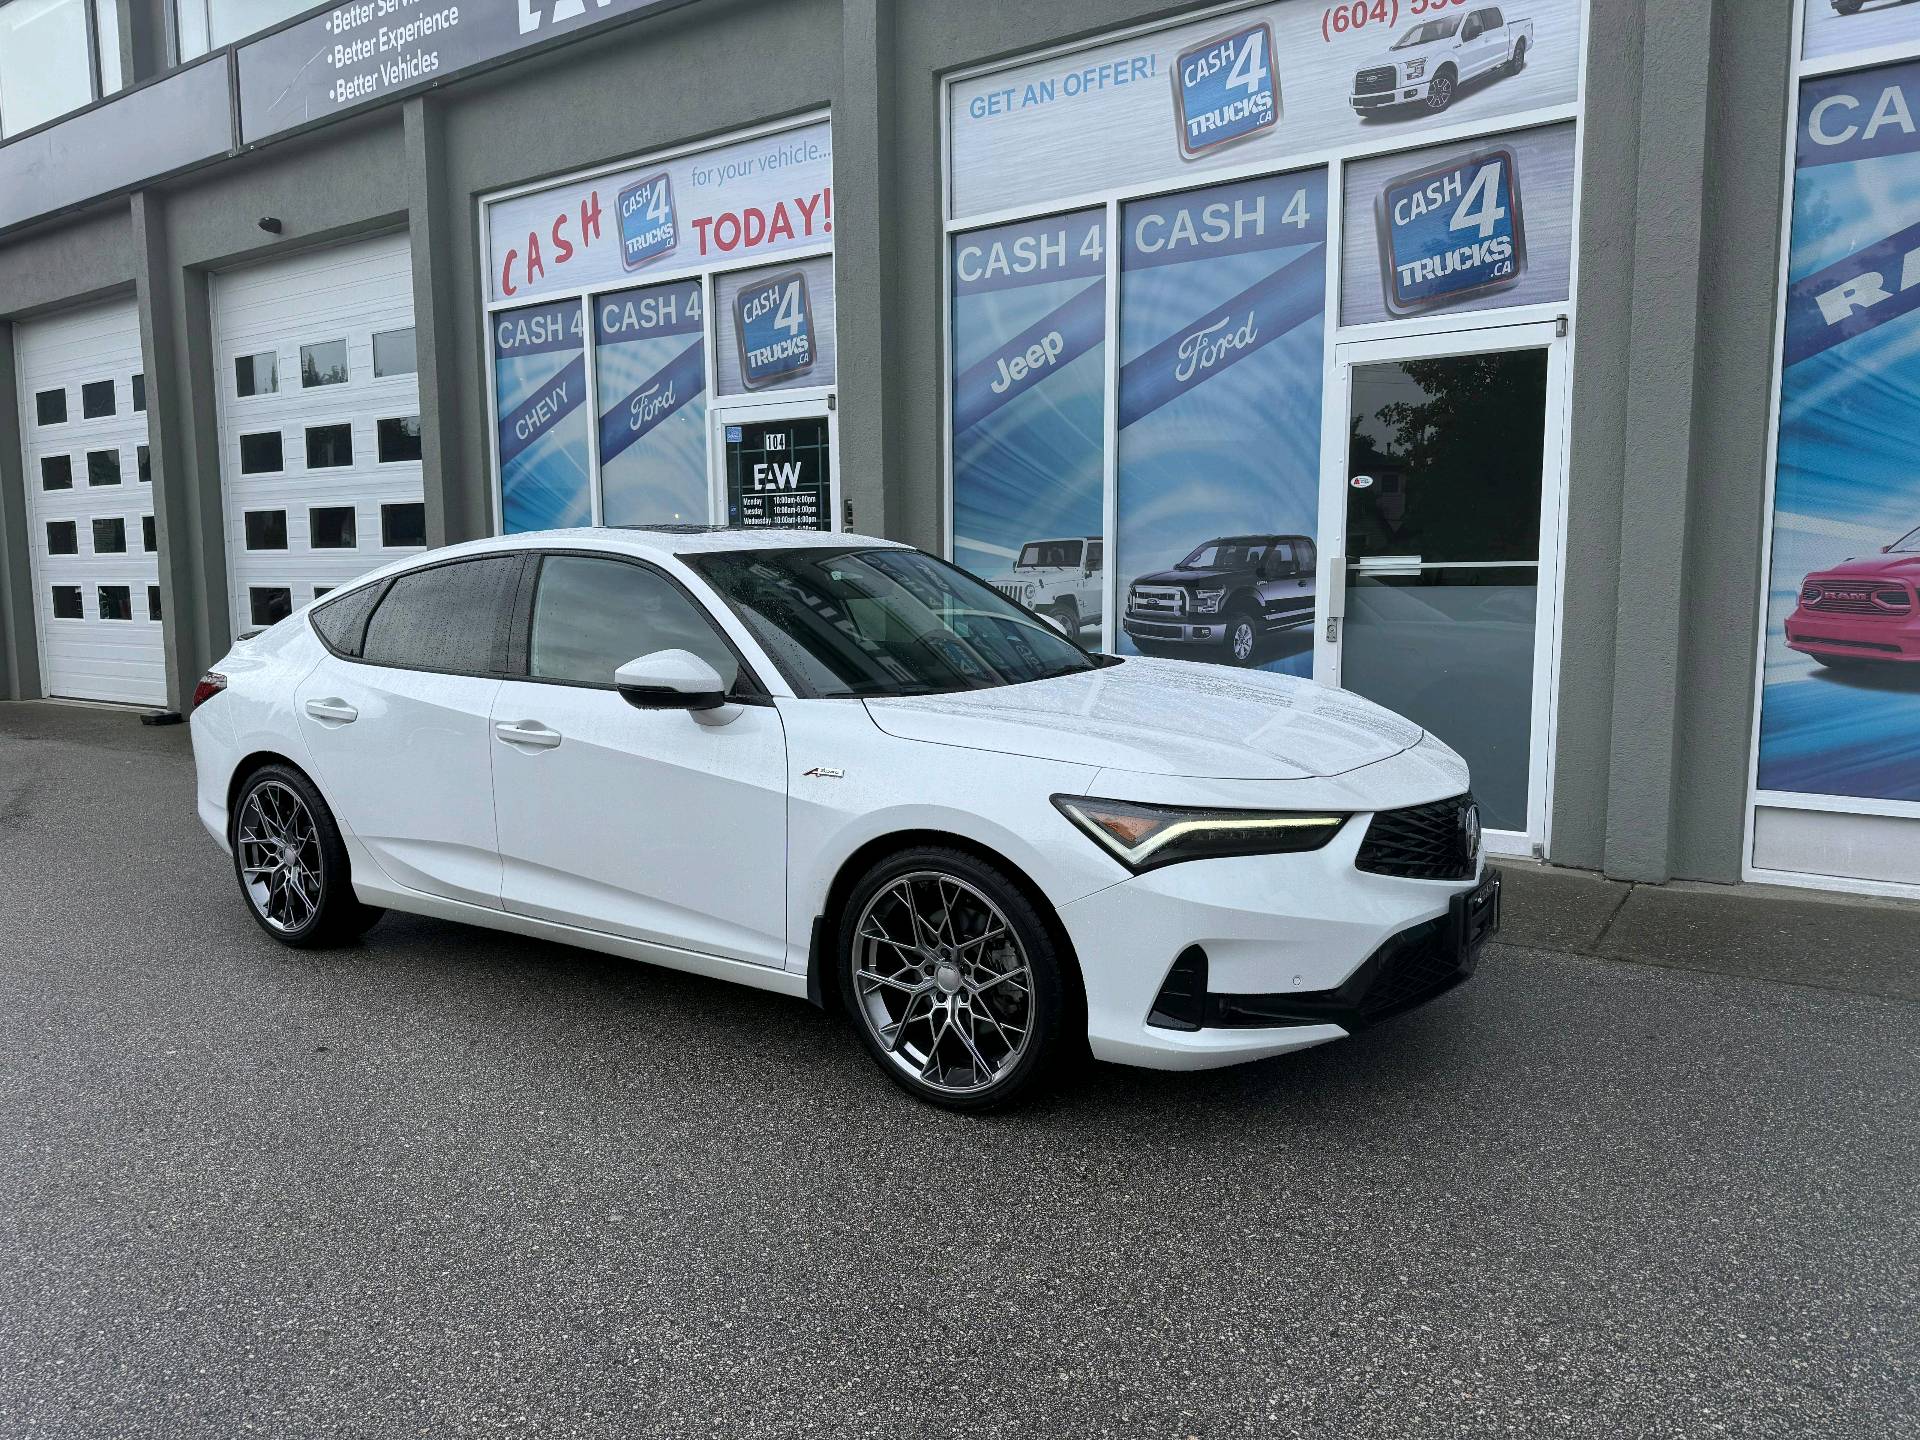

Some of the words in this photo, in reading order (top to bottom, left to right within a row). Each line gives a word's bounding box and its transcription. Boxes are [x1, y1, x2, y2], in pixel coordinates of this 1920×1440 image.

[333, 2, 375, 35] Better
[335, 37, 376, 68] Better
[379, 6, 459, 52] Experience
[1322, 0, 1399, 42] (604)
[337, 71, 378, 103] Better
[380, 49, 439, 86] Vehicles
[969, 88, 1016, 119] GET
[1021, 79, 1055, 108] AN
[1063, 54, 1156, 96] OFFER!
[1184, 41, 1236, 88] CASH
[1225, 30, 1268, 94] 4
[1187, 90, 1273, 137] TRUCKS
[692, 166, 714, 187] for
[717, 159, 753, 187] your
[622, 183, 651, 218] CASH
[646, 178, 670, 224] 4
[691, 187, 833, 256] TODAY!
[1135, 195, 1265, 253] CASH
[1281, 189, 1311, 229] 4
[1394, 170, 1463, 227] CASH
[1449, 161, 1505, 238] 4
[502, 190, 602, 296] CASH
[625, 222, 674, 254] TRUCKS
[957, 230, 1066, 282] CASH
[1079, 224, 1103, 262] 4
[1396, 236, 1512, 287] TRUCKS
[498, 314, 563, 349] CASH
[570, 309, 585, 338] 4
[602, 295, 677, 333] CASH
[685, 290, 702, 321] 4
[743, 286, 780, 324] CASH
[773, 279, 804, 336] 4
[748, 334, 810, 370] TRUCKS
[990, 330, 1064, 394] Jeep
[1175, 311, 1258, 382] Ford
[515, 382, 569, 440] CHEVY
[630, 381, 676, 431] Ford
[767, 434, 785, 449] 104
[743, 497, 763, 506] Monday
[743, 507, 763, 516] Tuesday
[743, 517, 771, 525] Wednesday
